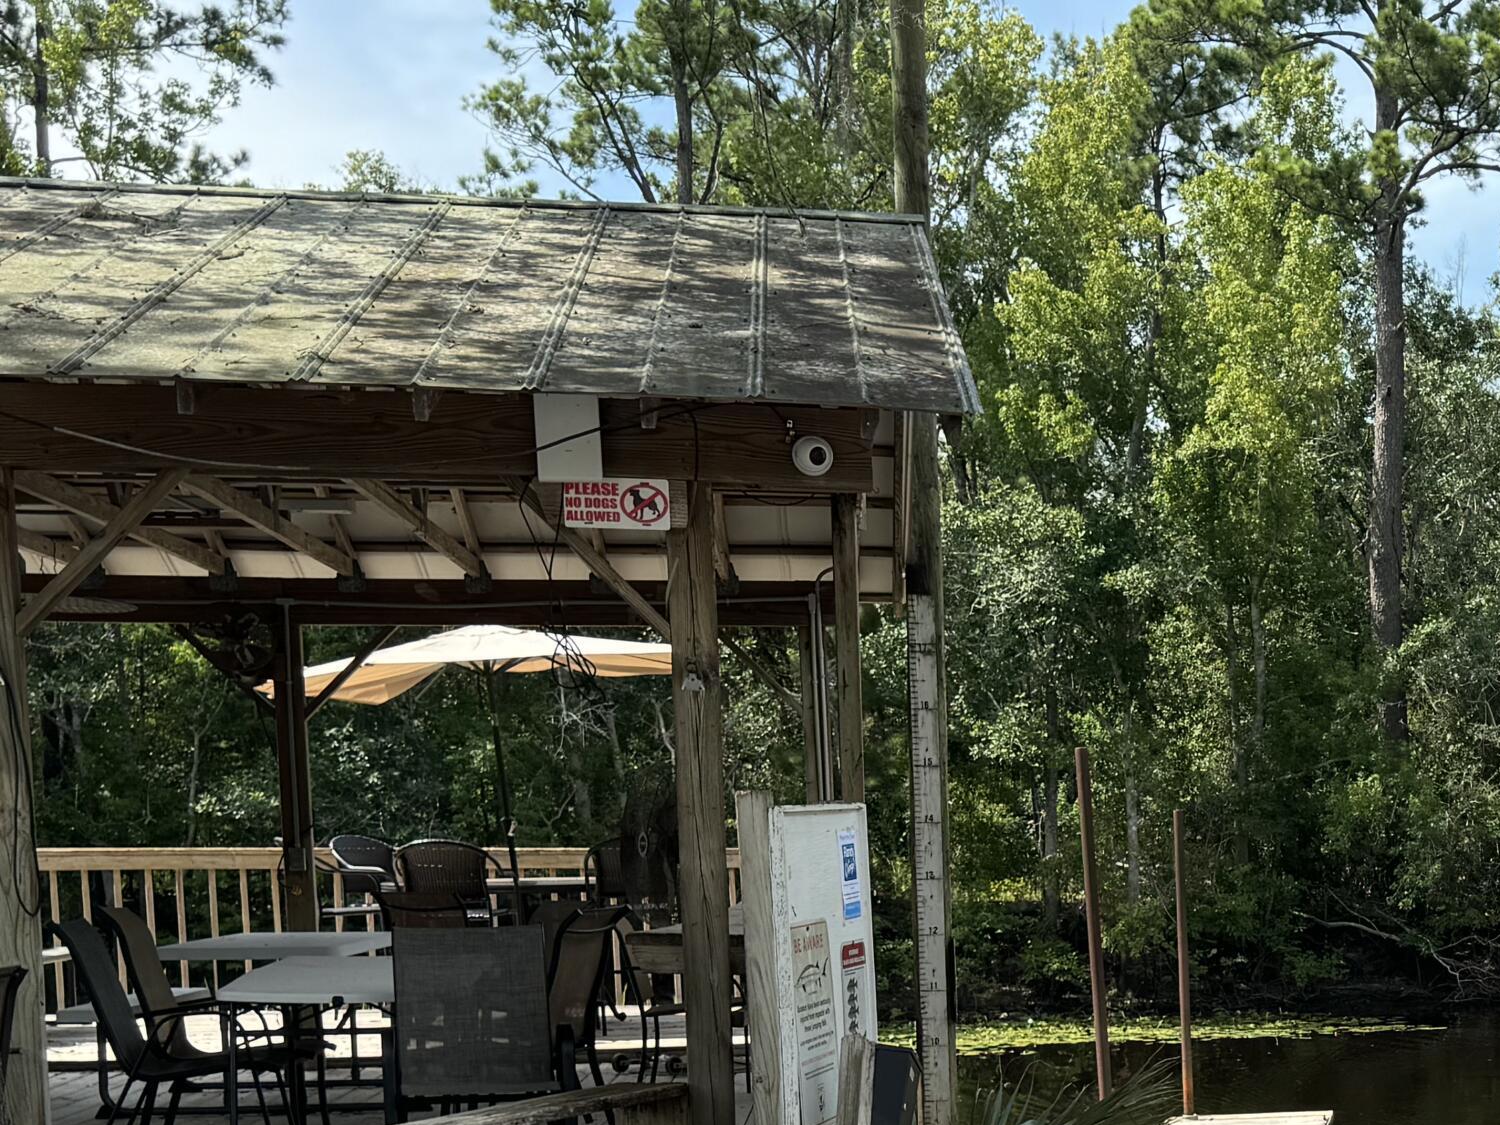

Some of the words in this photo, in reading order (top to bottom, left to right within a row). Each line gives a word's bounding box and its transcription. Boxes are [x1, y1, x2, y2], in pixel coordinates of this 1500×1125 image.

[565, 482, 619, 496] PLEASE
[566, 497, 582, 508] NO
[584, 498, 617, 509] DOGS
[566, 510, 620, 522] ALLOWED
[921, 700, 929, 710] 16
[923, 757, 932, 767] 15
[929, 926, 938, 935] 12
[794, 938, 802, 953] BE
[803, 934, 823, 952] AWARE
[930, 982, 937, 990] 11
[931, 1037, 940, 1046] 10
